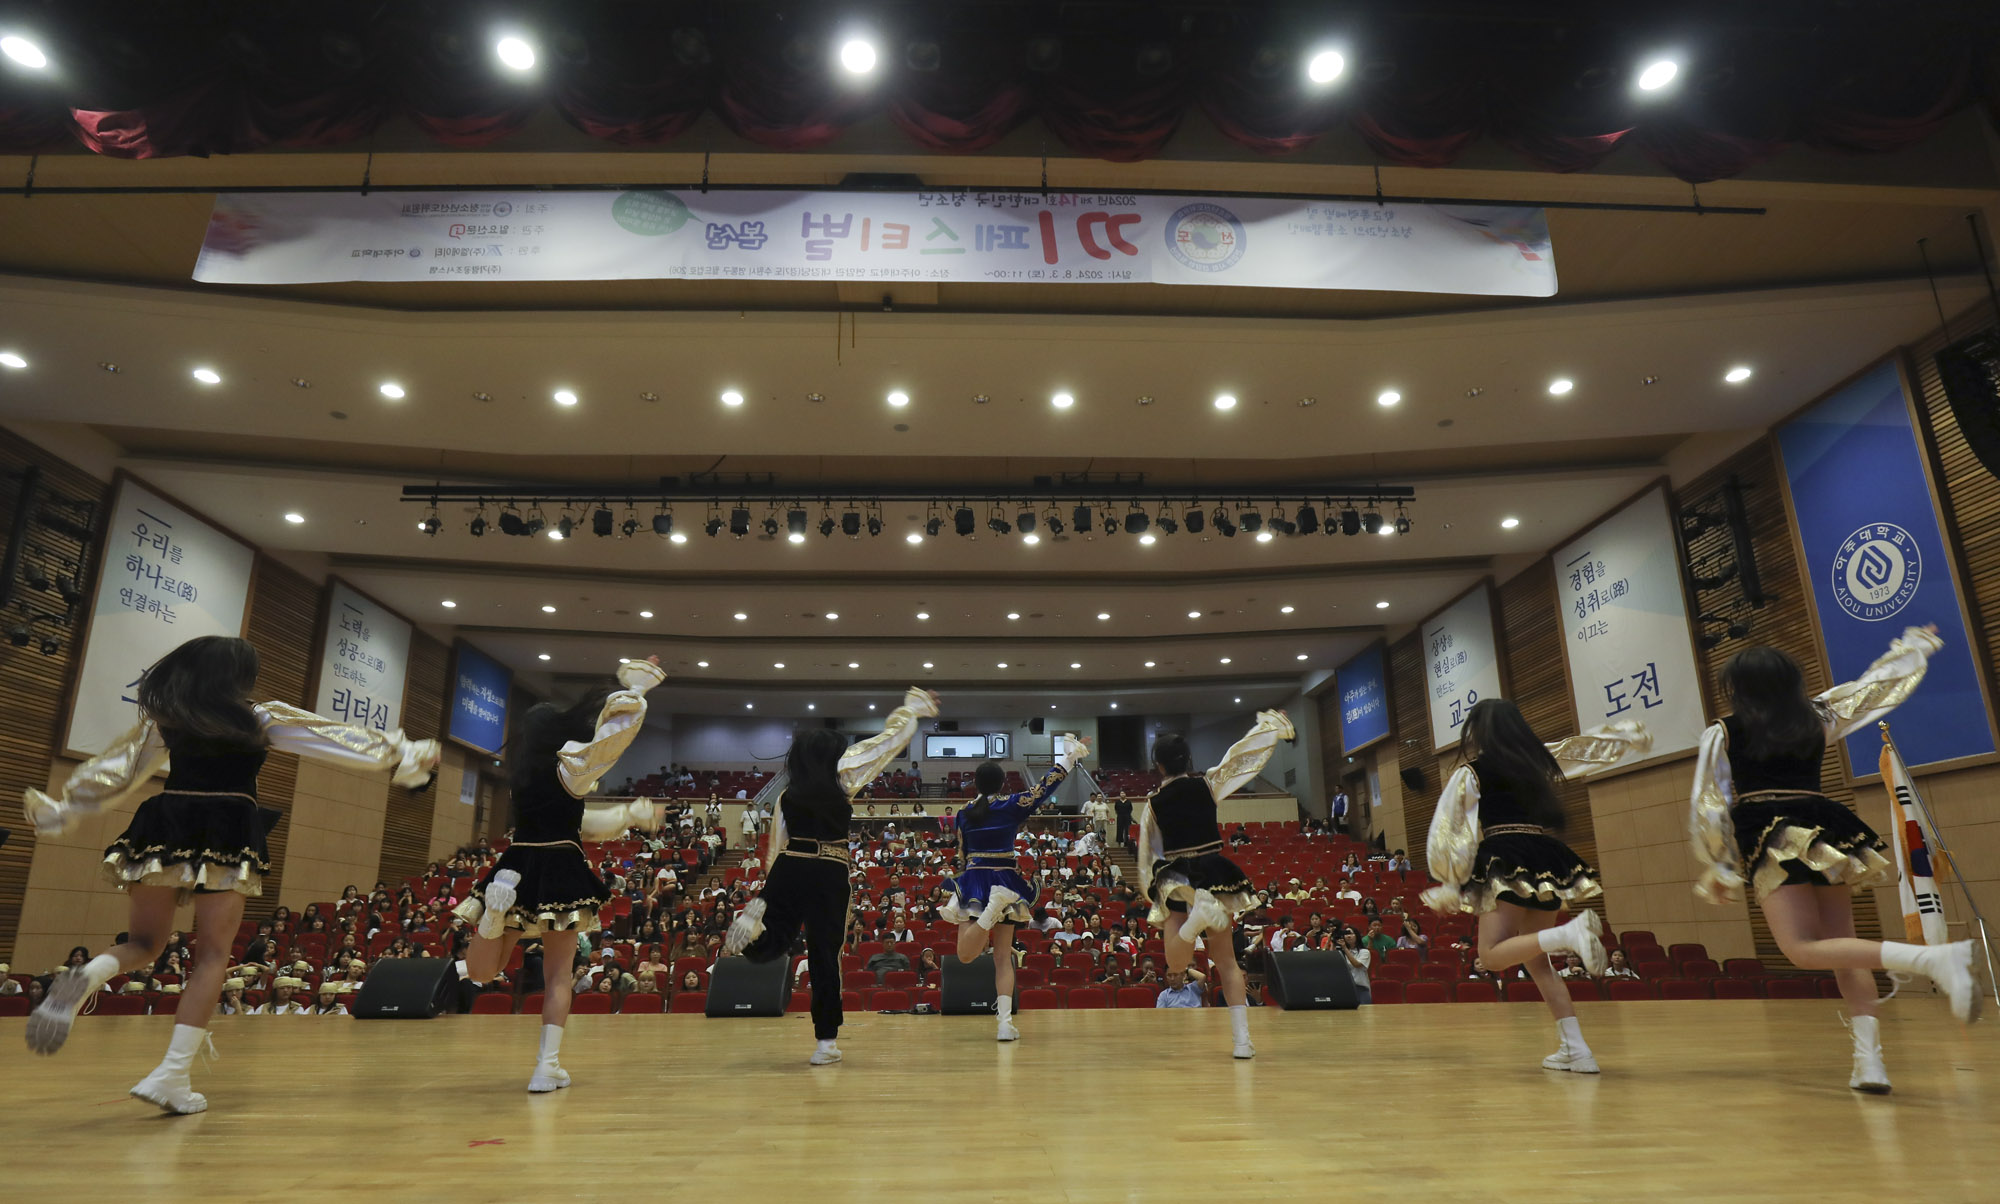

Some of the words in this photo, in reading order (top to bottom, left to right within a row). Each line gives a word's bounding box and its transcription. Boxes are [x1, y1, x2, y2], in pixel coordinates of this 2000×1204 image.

[131, 523, 183, 565] 우리를
[1836, 526, 1906, 570] 아주대학교
[126, 554, 198, 603] 하나로(路)
[1569, 560, 1606, 592] 경험을
[1837, 587, 1861, 613] AJOU
[1866, 560, 1917, 617] UNIVERSITY
[1869, 586, 1890, 600] 1973
[120, 587, 177, 624] 연결하는
[1574, 578, 1629, 619] 성취로(路)
[339, 613, 371, 643] 노력을
[1431, 634, 1454, 657] 상상을
[1577, 620, 1609, 643] 이끄는
[333, 662, 367, 688] 인도하는
[1433, 650, 1468, 679] 현실로(路)
[1604, 662, 1664, 718] 도전
[332, 688, 389, 731] 리더십
